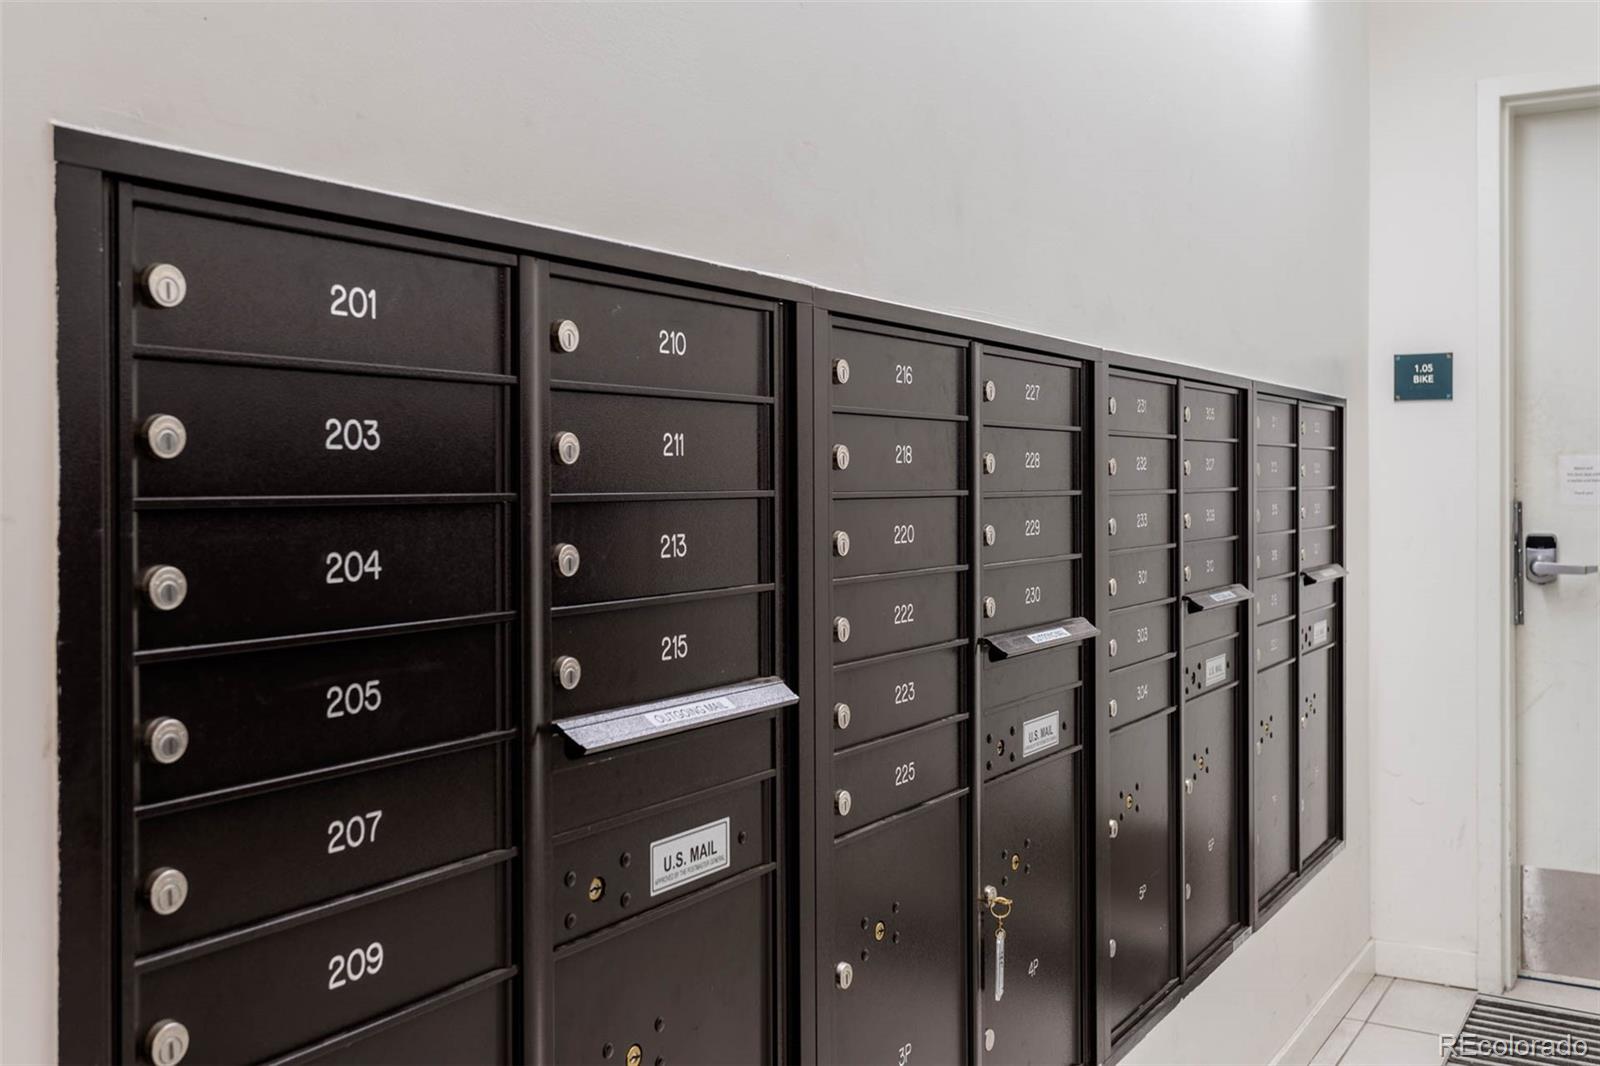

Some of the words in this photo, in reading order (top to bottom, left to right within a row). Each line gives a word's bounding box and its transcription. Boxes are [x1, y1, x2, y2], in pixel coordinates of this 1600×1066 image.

[331, 285, 376, 319] 201
[660, 330, 686, 355] 210
[896, 365, 912, 384] 216
[1414, 363, 1434, 373] 1.05
[1413, 374, 1434, 384] BIKE
[1026, 384, 1040, 400] 227
[1137, 399, 1147, 413] 231
[326, 418, 380, 450] 203
[664, 433, 683, 456] 211
[896, 445, 912, 463] 218
[1026, 452, 1040, 468] 228
[1137, 457, 1147, 470] 232
[1026, 520, 1040, 536] 229
[1137, 513, 1147, 528] 233
[894, 525, 914, 544] 220
[661, 534, 687, 558] 213
[326, 550, 382, 583] 204
[1138, 570, 1147, 584] 301
[1026, 587, 1040, 604] 230
[895, 604, 913, 624] 222
[1137, 627, 1147, 643] 303
[662, 634, 687, 660] 215
[327, 680, 381, 718] 205
[895, 682, 915, 704] 223
[1137, 685, 1148, 700] 304
[654, 705, 707, 723] OUTGOING
[704, 700, 729, 714] MAIL
[1040, 725, 1054, 738] MAIL
[896, 762, 915, 785] 225
[328, 811, 382, 853] 207
[664, 851, 686, 872] U.S.
[690, 840, 718, 863] MAIL
[1139, 884, 1146, 900] 5P
[329, 942, 383, 989] 209
[1029, 959, 1038, 976] 4P
[899, 1043, 911, 1066] 3P
